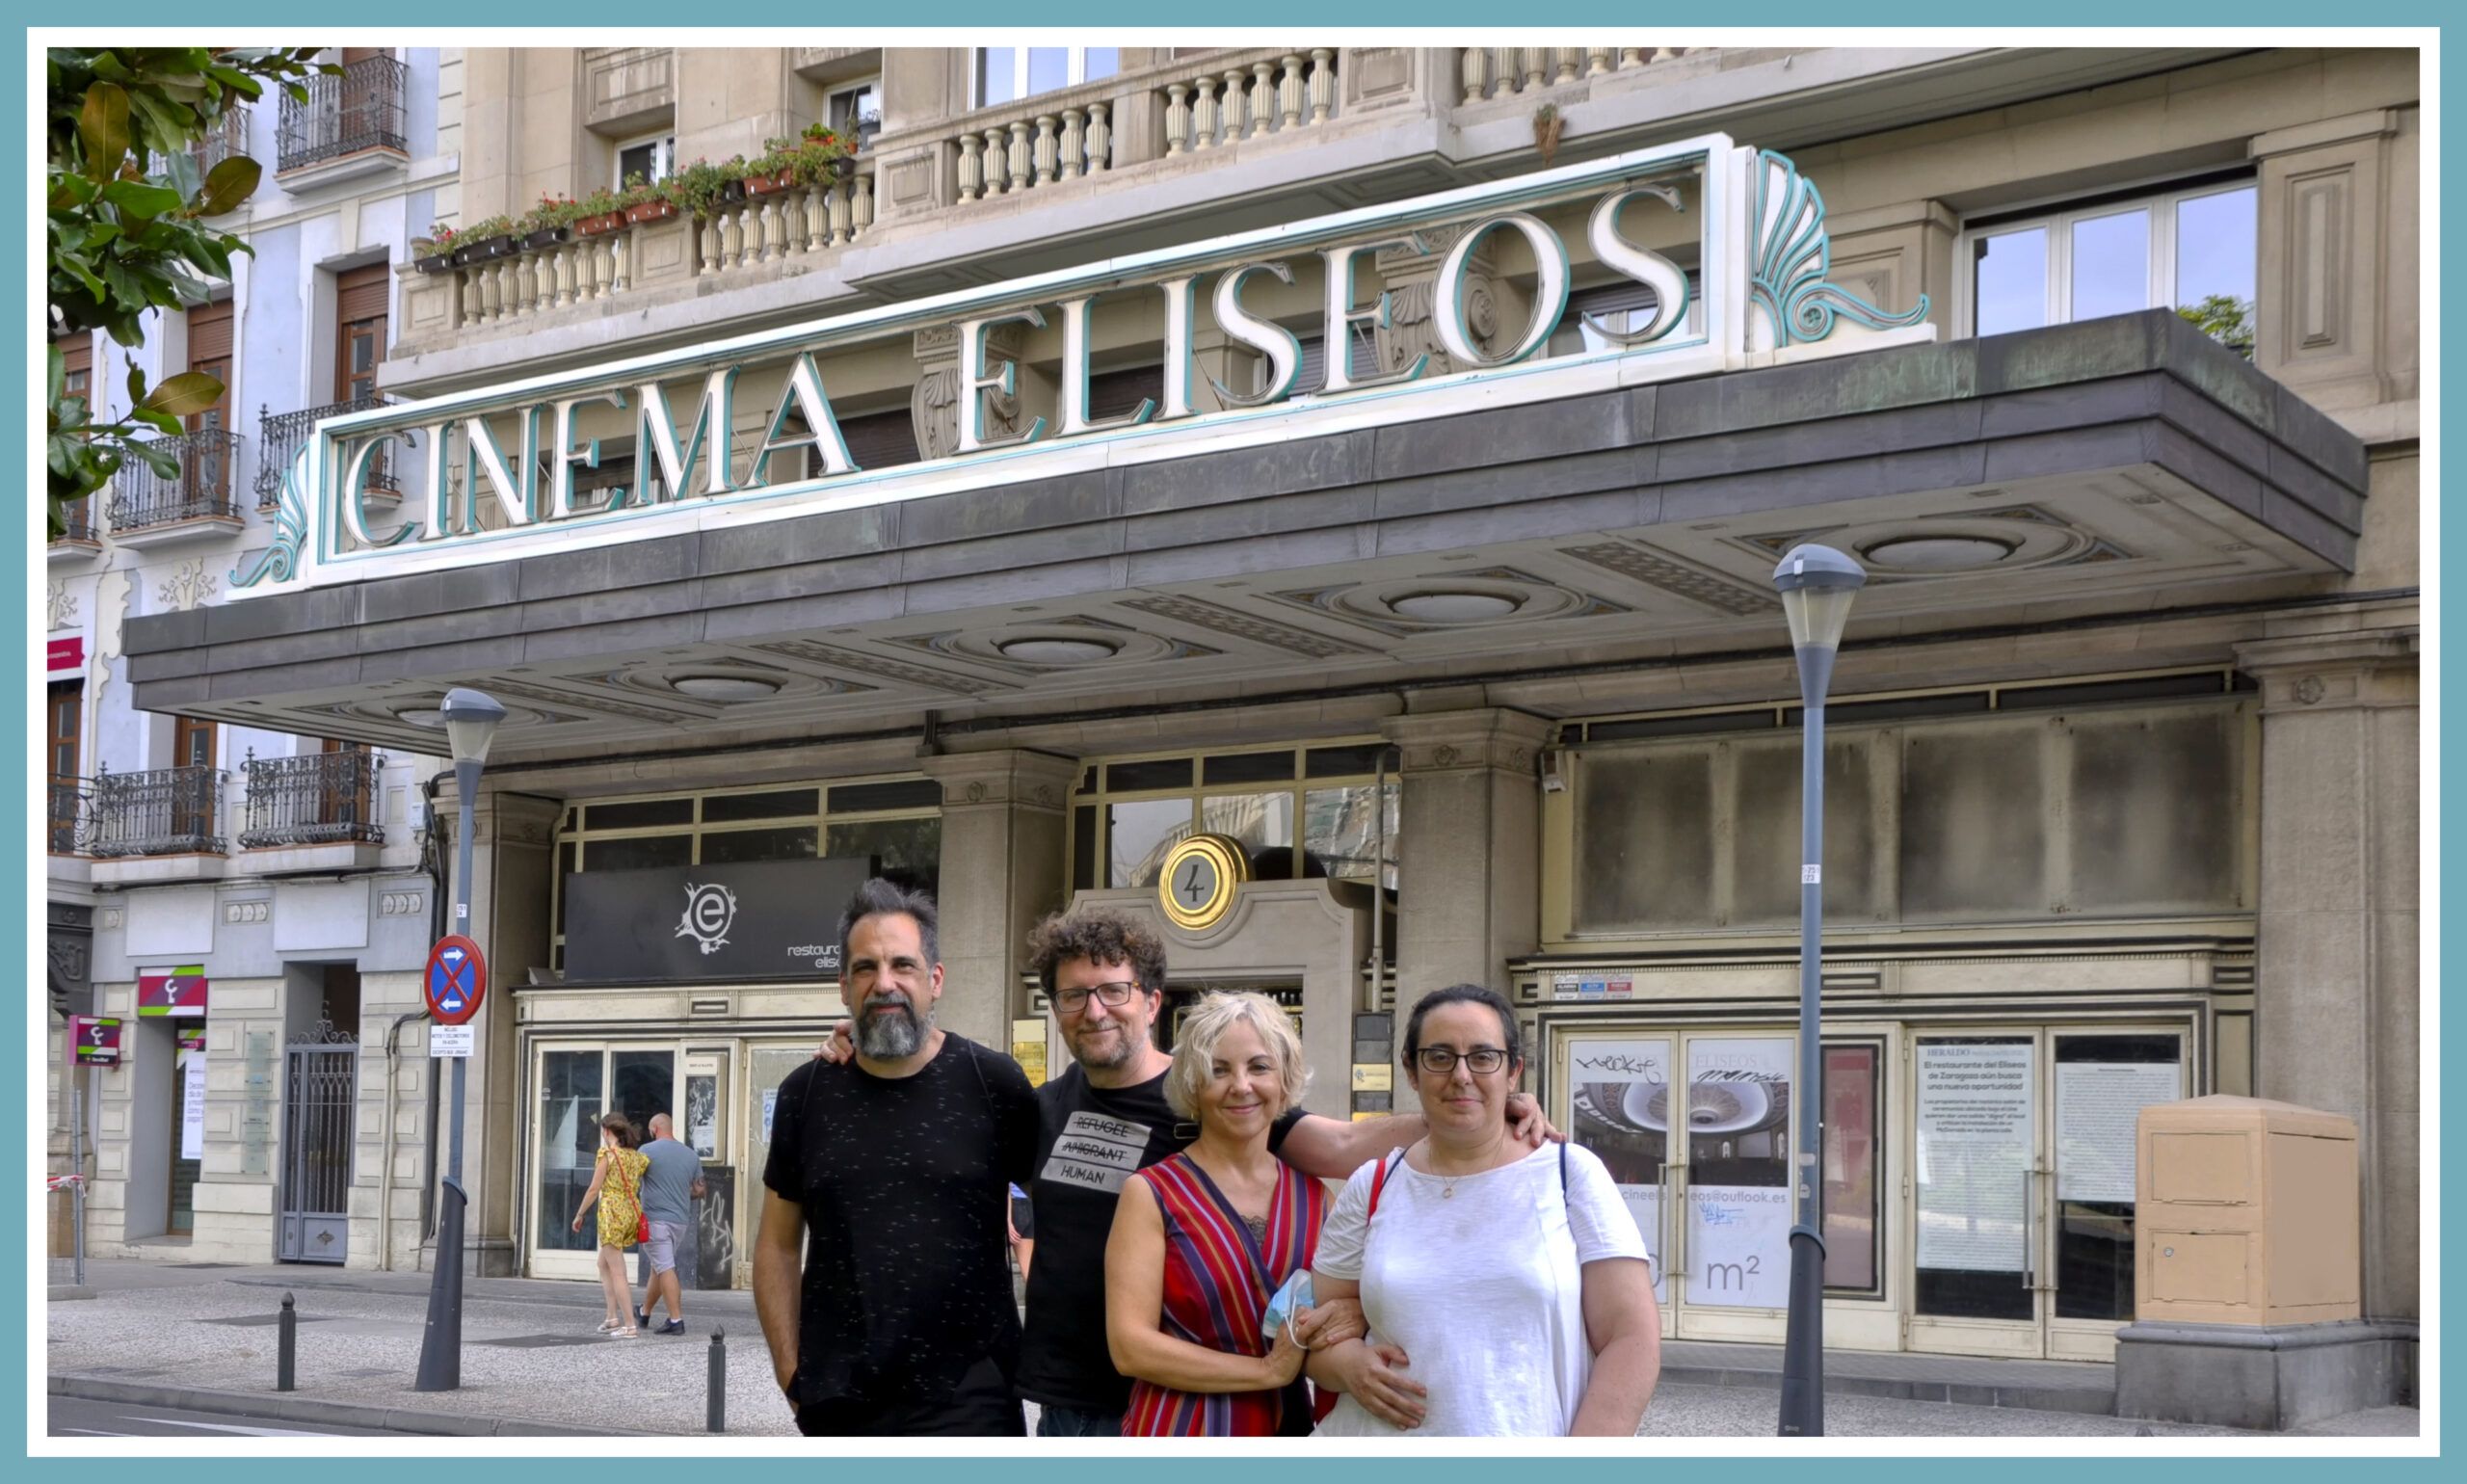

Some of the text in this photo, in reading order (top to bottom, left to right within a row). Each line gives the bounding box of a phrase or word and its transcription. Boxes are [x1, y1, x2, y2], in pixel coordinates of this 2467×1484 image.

[342, 184, 1690, 547] CINEMA ELISEOS
[1183, 864, 1205, 902] 4
[696, 893, 726, 932] e
[1927, 1047, 1971, 1057] HERALDO
[1998, 1060, 2027, 1069] Eliseos
[1939, 1072, 1979, 1081] Zaragoza
[1971, 1082, 2024, 1091] oportunidad
[1075, 1116, 1128, 1138] REFUGEE
[1060, 1164, 1105, 1184] HUMAN
[1622, 1188, 1667, 1201] cineels
